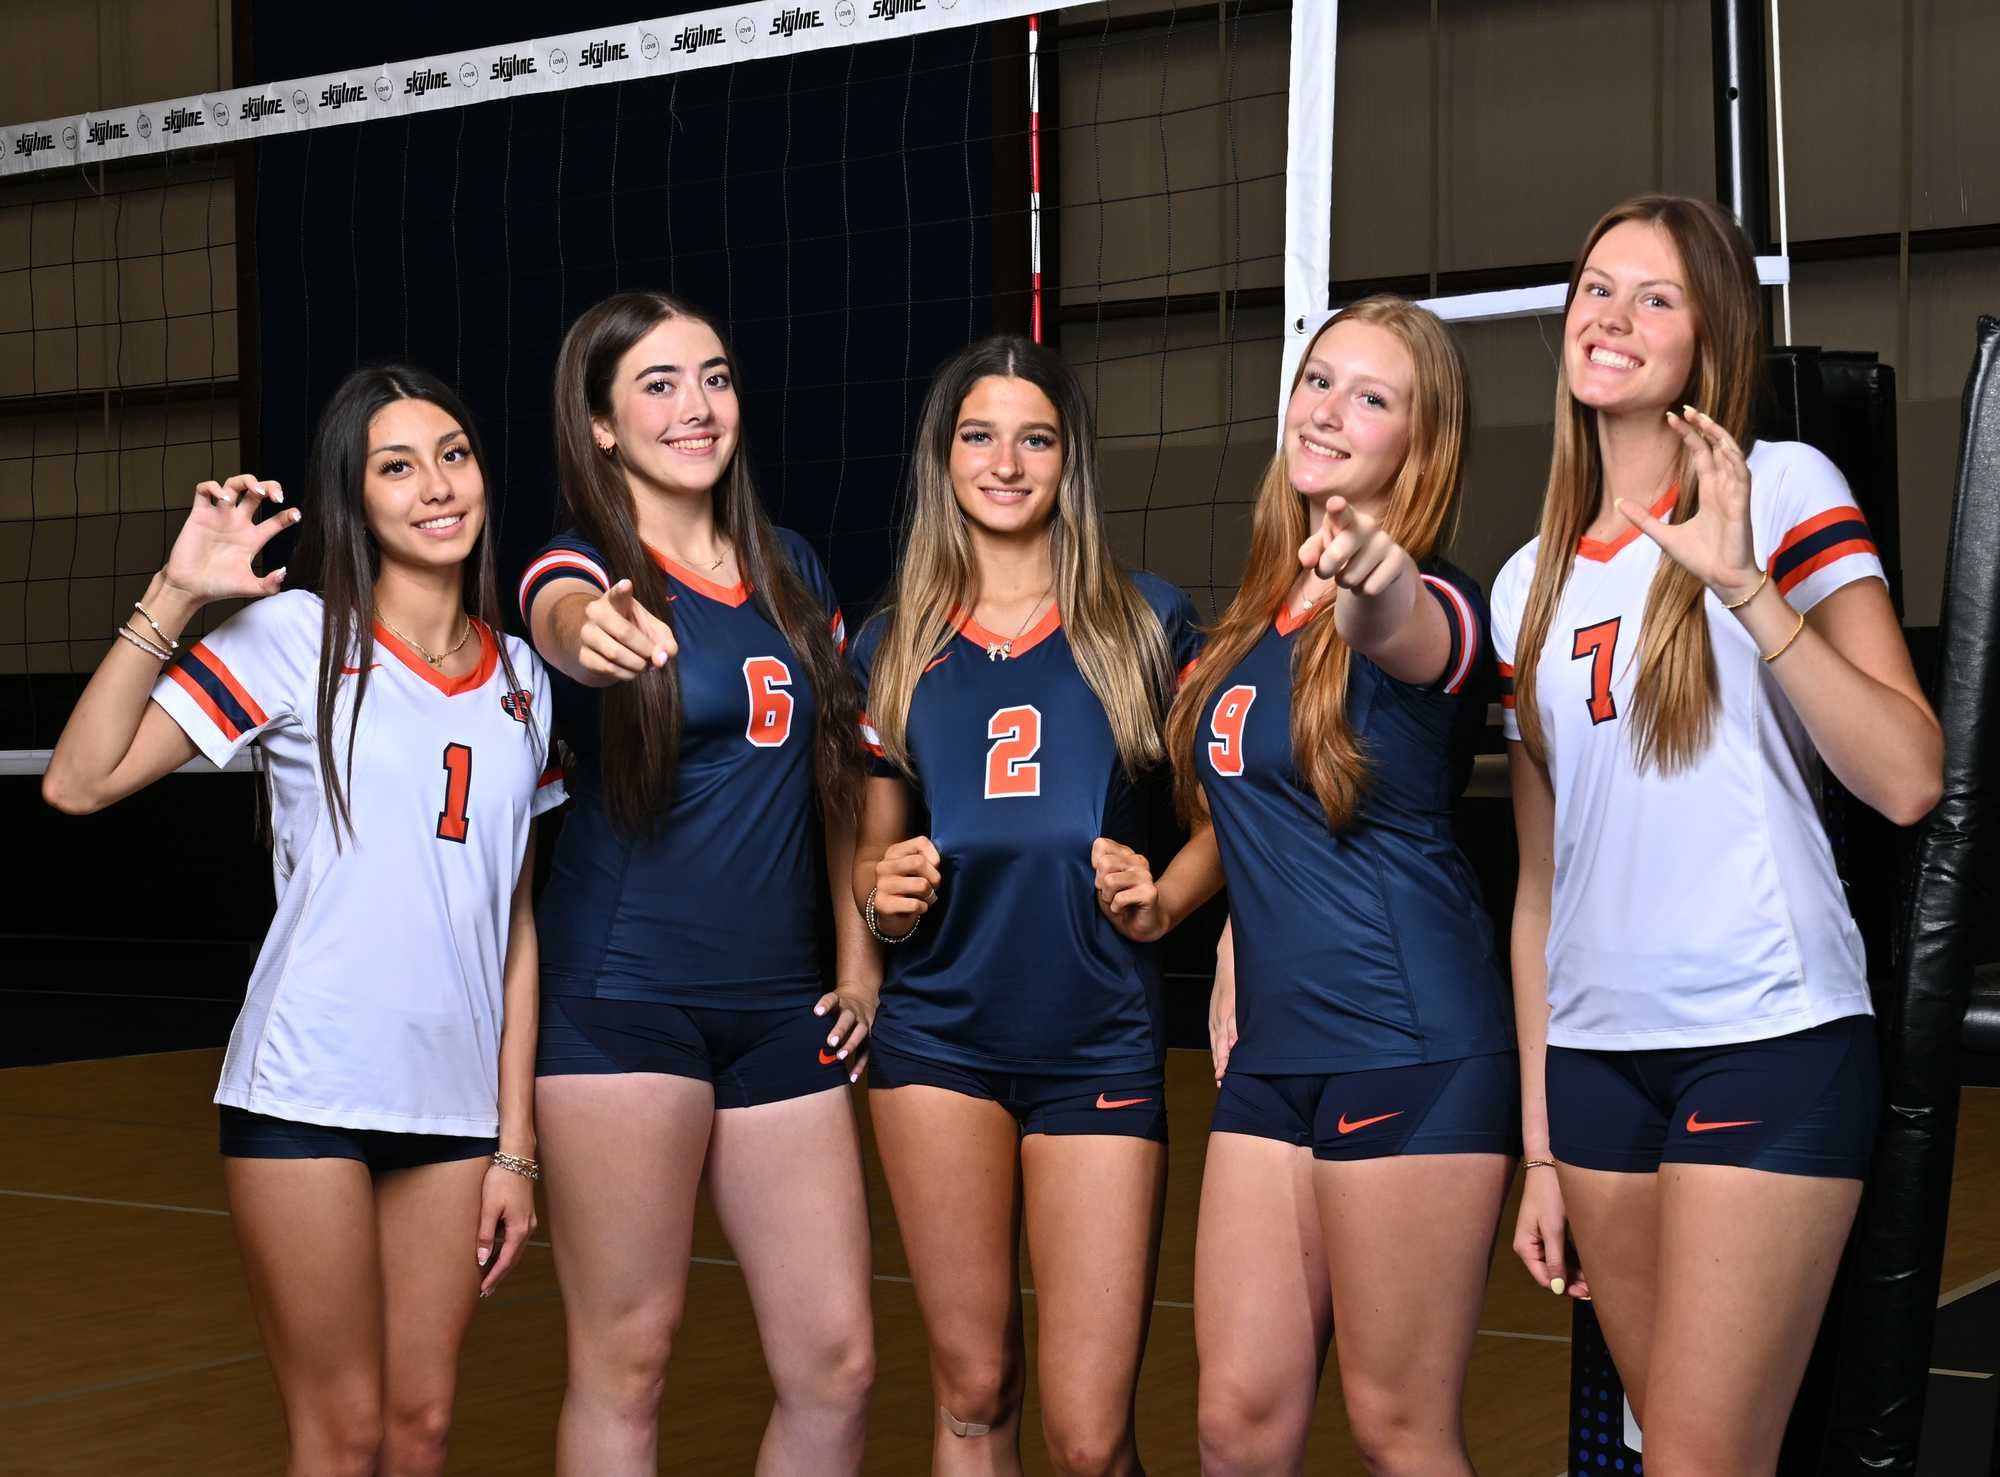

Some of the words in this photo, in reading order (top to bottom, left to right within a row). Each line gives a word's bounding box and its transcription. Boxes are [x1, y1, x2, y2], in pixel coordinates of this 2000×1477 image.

[742, 656, 794, 748] 6
[1571, 616, 1622, 726] 7
[984, 704, 1041, 800] 2
[1208, 685, 1257, 777] 9
[436, 742, 473, 845] 1
